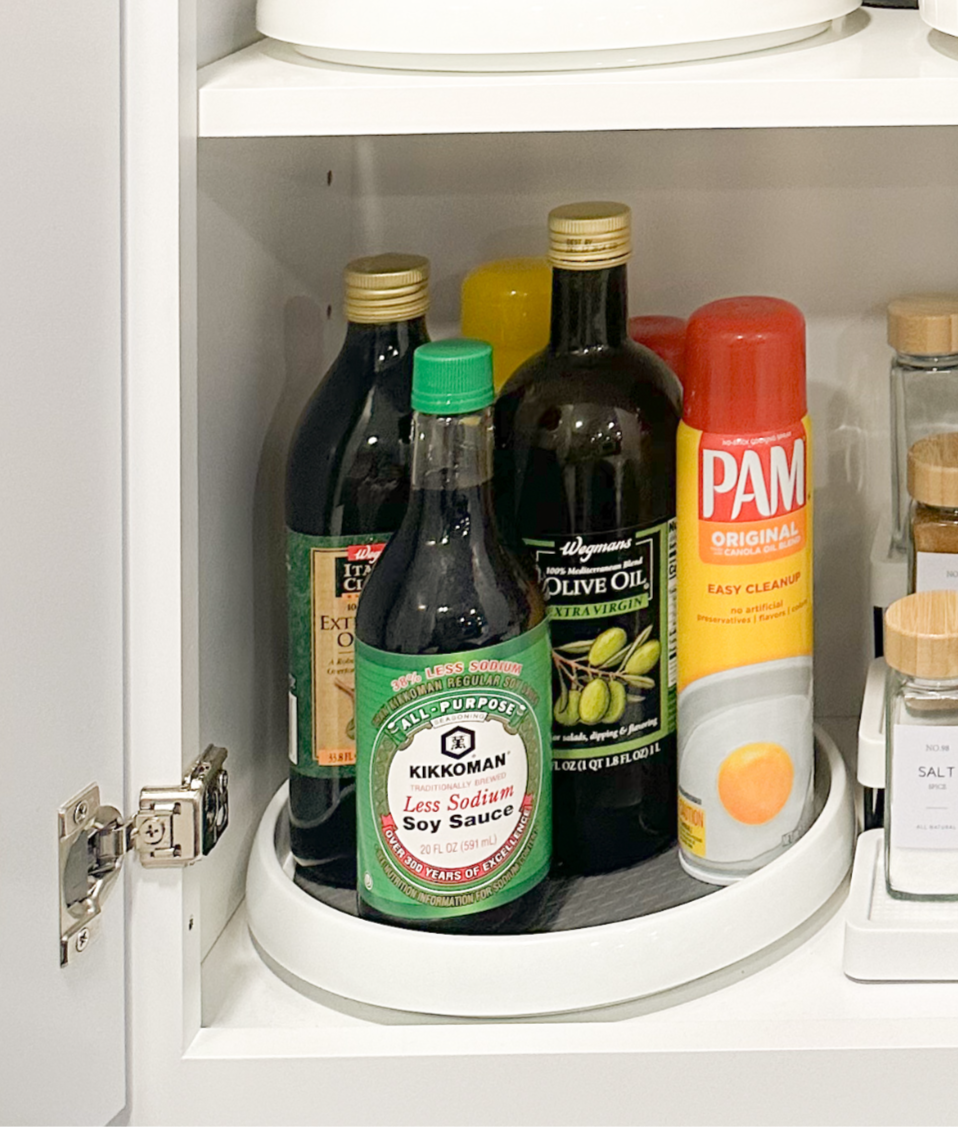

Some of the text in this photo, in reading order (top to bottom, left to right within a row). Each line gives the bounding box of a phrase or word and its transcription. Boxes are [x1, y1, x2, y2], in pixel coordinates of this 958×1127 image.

[702, 438, 805, 521] PAM
[711, 521, 799, 547] ORIGINAL
[724, 535, 801, 556] CANOLA OIL BLEND
[559, 535, 633, 563] Wegmans
[546, 569, 647, 596] OLIVE OIL
[707, 571, 801, 595] EASY CLEANUP
[593, 596, 643, 617] VIRGIN
[697, 609, 786, 625] preservatives flavors
[731, 599, 784, 615] no artificial
[390, 659, 523, 692] 38% LESS SODIUM
[389, 680, 443, 711] KIKKOMAN
[447, 674, 501, 688] REGULAR
[401, 697, 516, 732] ALL-PURPOSE
[434, 713, 485, 726] SEASONING
[619, 726, 628, 736] &
[409, 752, 506, 779] KIKKOMAN
[562, 753, 632, 771] OZ QT FL
[918, 765, 955, 778] SALT
[410, 772, 507, 792] TRADITIONALLY BREWED
[403, 784, 514, 813] Less Sodium
[402, 804, 514, 834] Soy Sauce
[385, 809, 532, 881] OVER 300 YEARS OF EXCELLENCE
[420, 833, 497, 855] 20 FL OZ (591 mL)
[417, 891, 474, 908] INFORMATION
[475, 887, 493, 901] FOR
